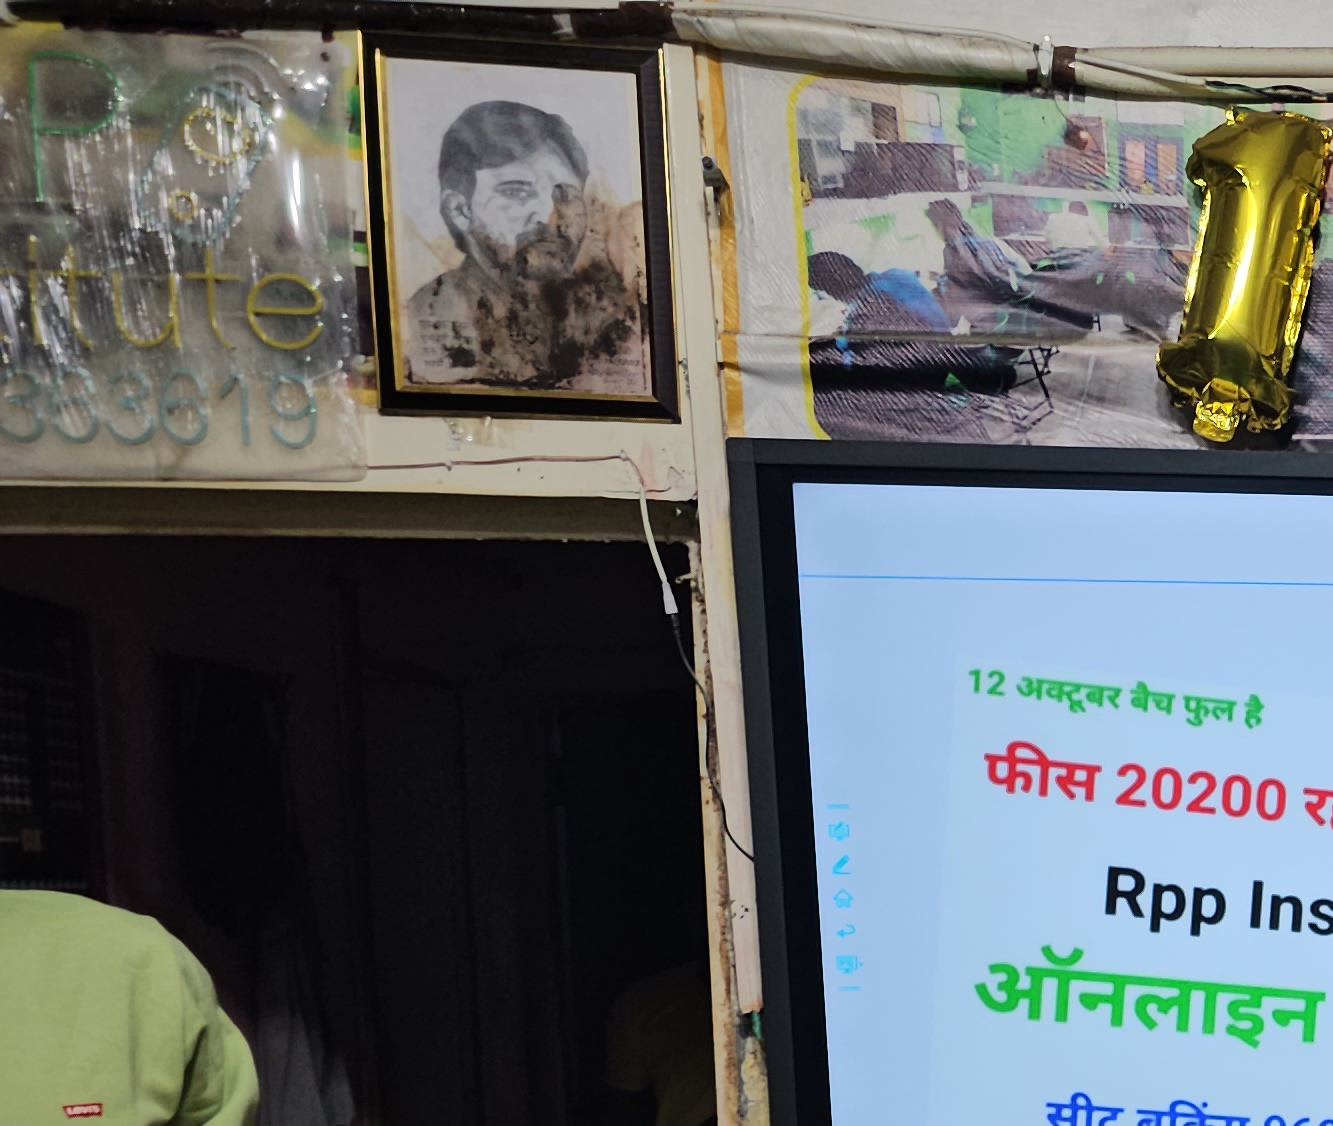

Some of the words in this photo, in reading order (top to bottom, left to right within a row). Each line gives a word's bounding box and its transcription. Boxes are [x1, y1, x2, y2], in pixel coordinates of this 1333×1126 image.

[968, 668, 1007, 697] 12
[1016, 674, 1121, 714] अक्टूबर
[1130, 681, 1176, 716] बैच
[1183, 692, 1236, 727] फुल
[1243, 694, 1265, 729] है
[984, 740, 1102, 803] फीस
[1115, 763, 1287, 822] 20200
[1103, 865, 1227, 937] Rpp
[974, 944, 1327, 1049] ऑनलाइन
